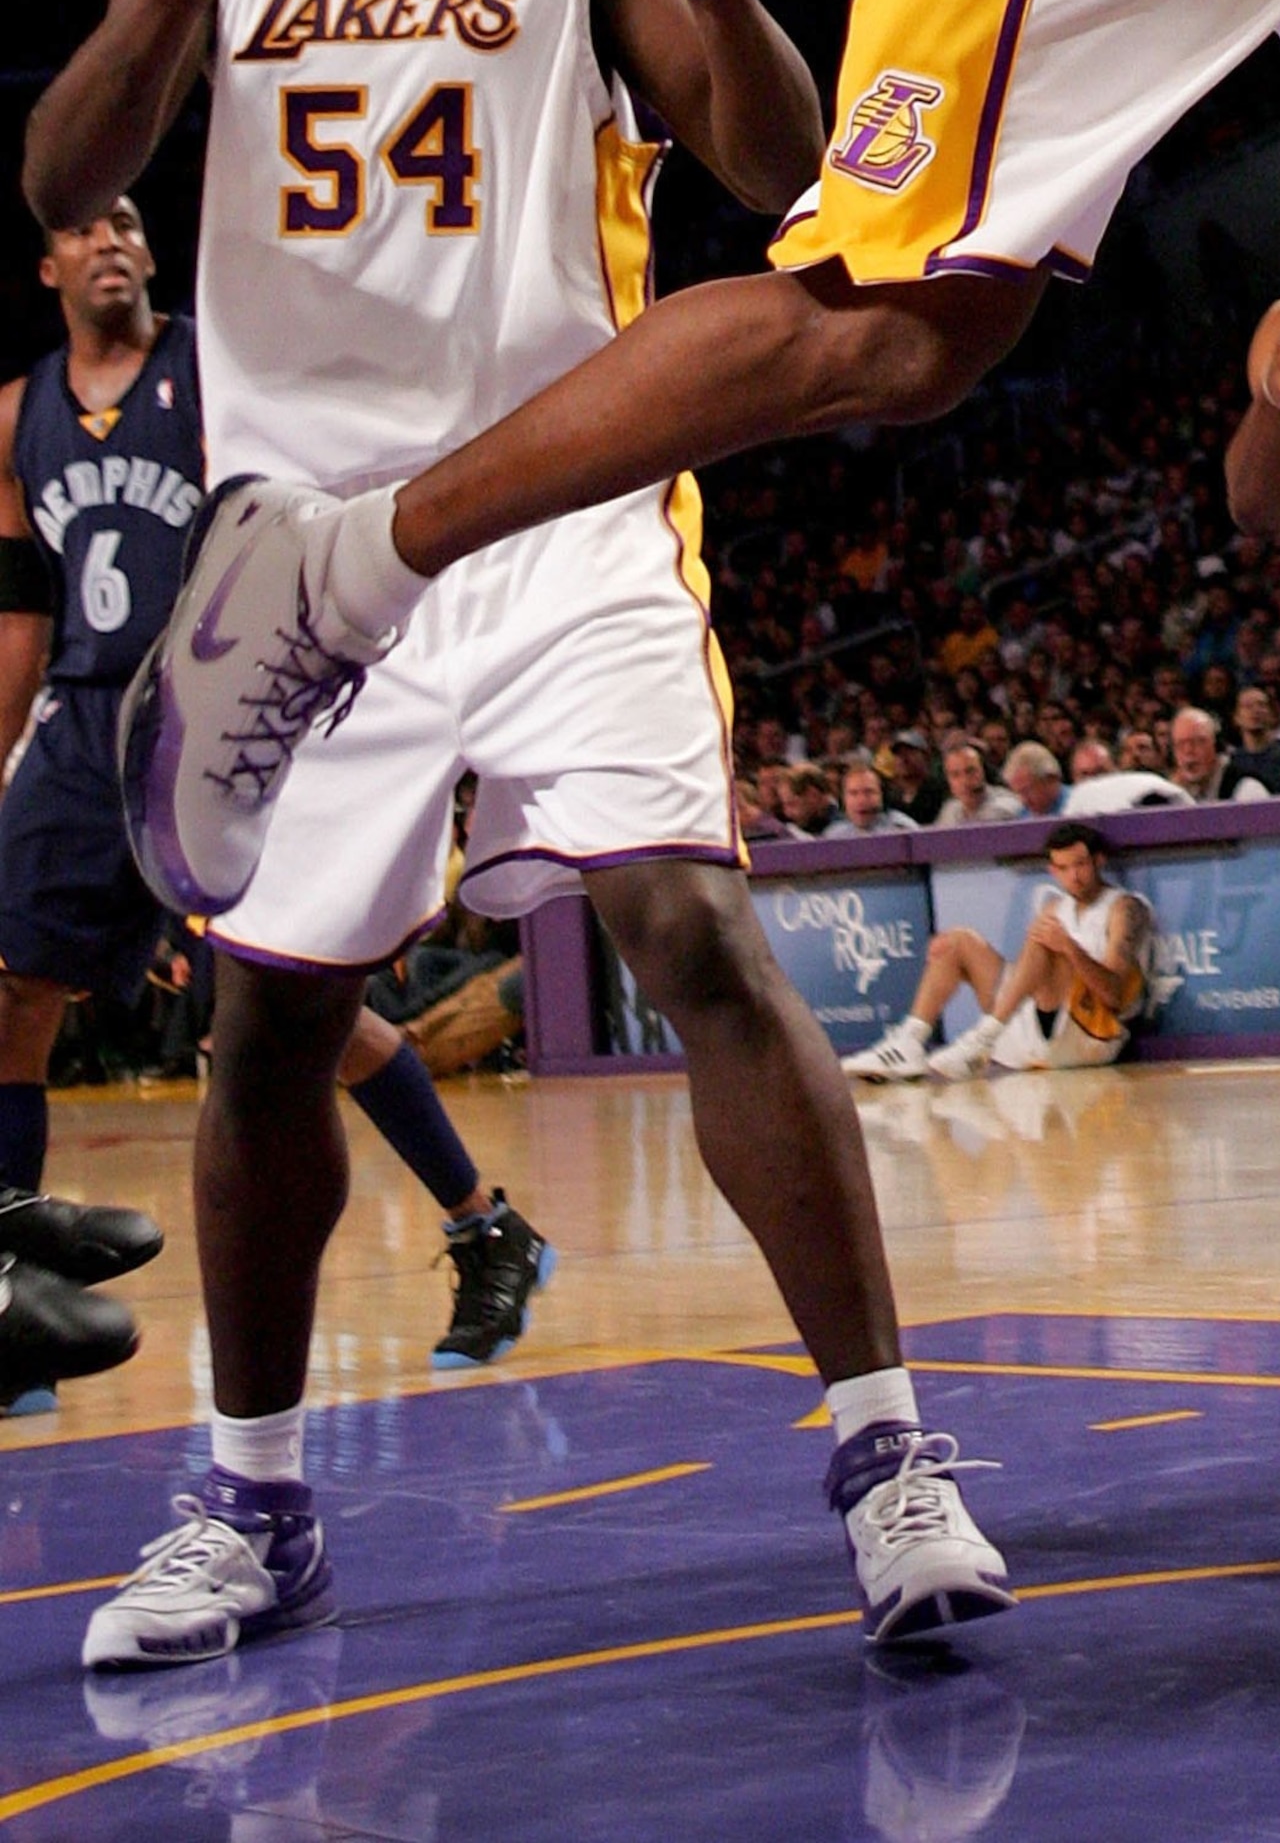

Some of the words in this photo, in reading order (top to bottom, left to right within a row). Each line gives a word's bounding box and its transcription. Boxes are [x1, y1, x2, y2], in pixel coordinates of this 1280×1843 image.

[278, 80, 484, 240] 54
[33, 455, 202, 555] MEMPHIS
[81, 529, 131, 634] 6
[773, 886, 865, 932] CASINO
